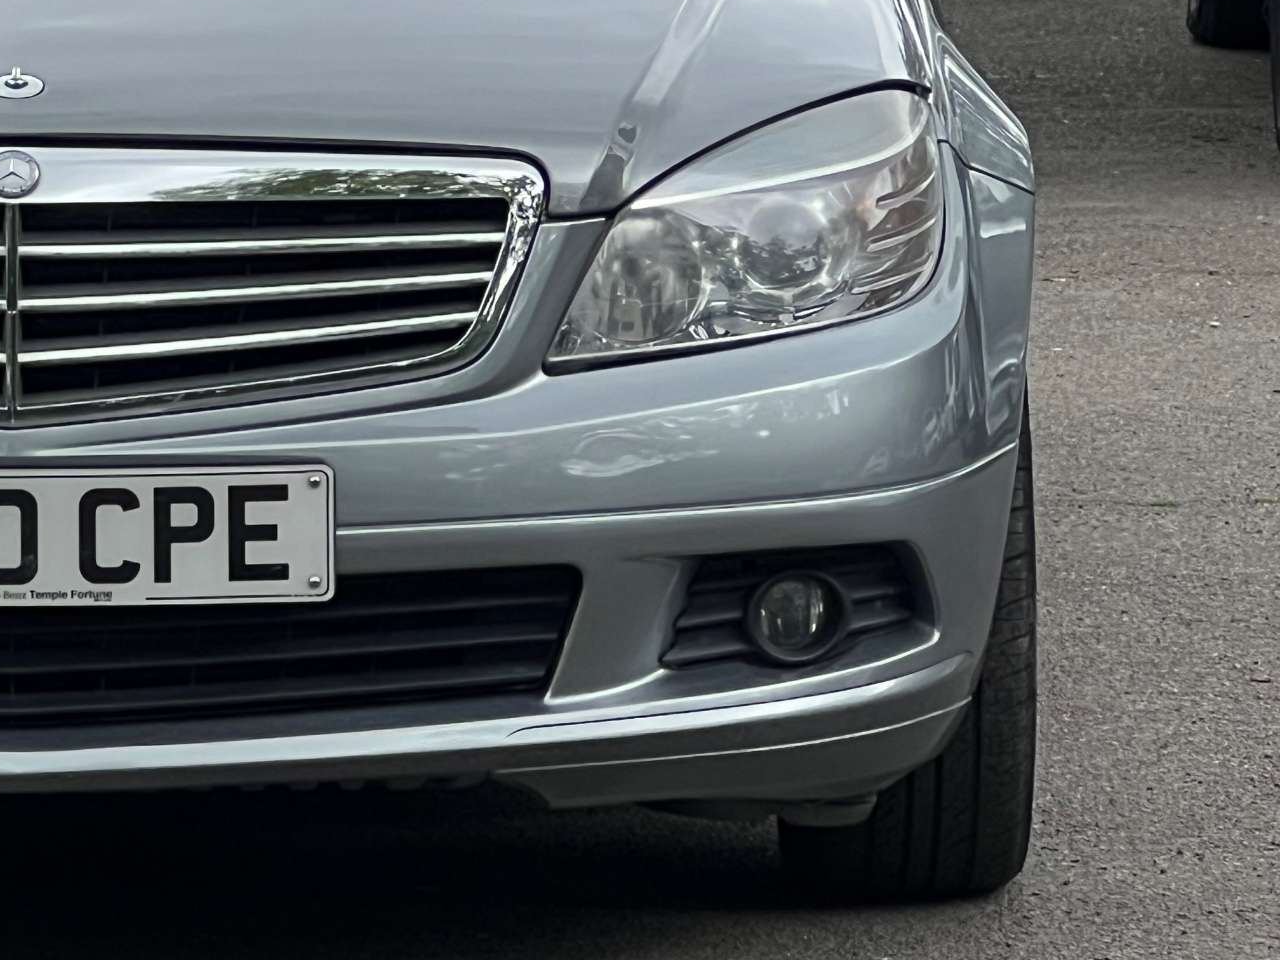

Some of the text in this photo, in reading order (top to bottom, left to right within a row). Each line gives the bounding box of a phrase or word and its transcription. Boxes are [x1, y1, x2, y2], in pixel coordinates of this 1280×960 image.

[78, 483, 290, 584] CPE
[29, 590, 68, 601] Temple
[70, 590, 113, 602] Fortune
